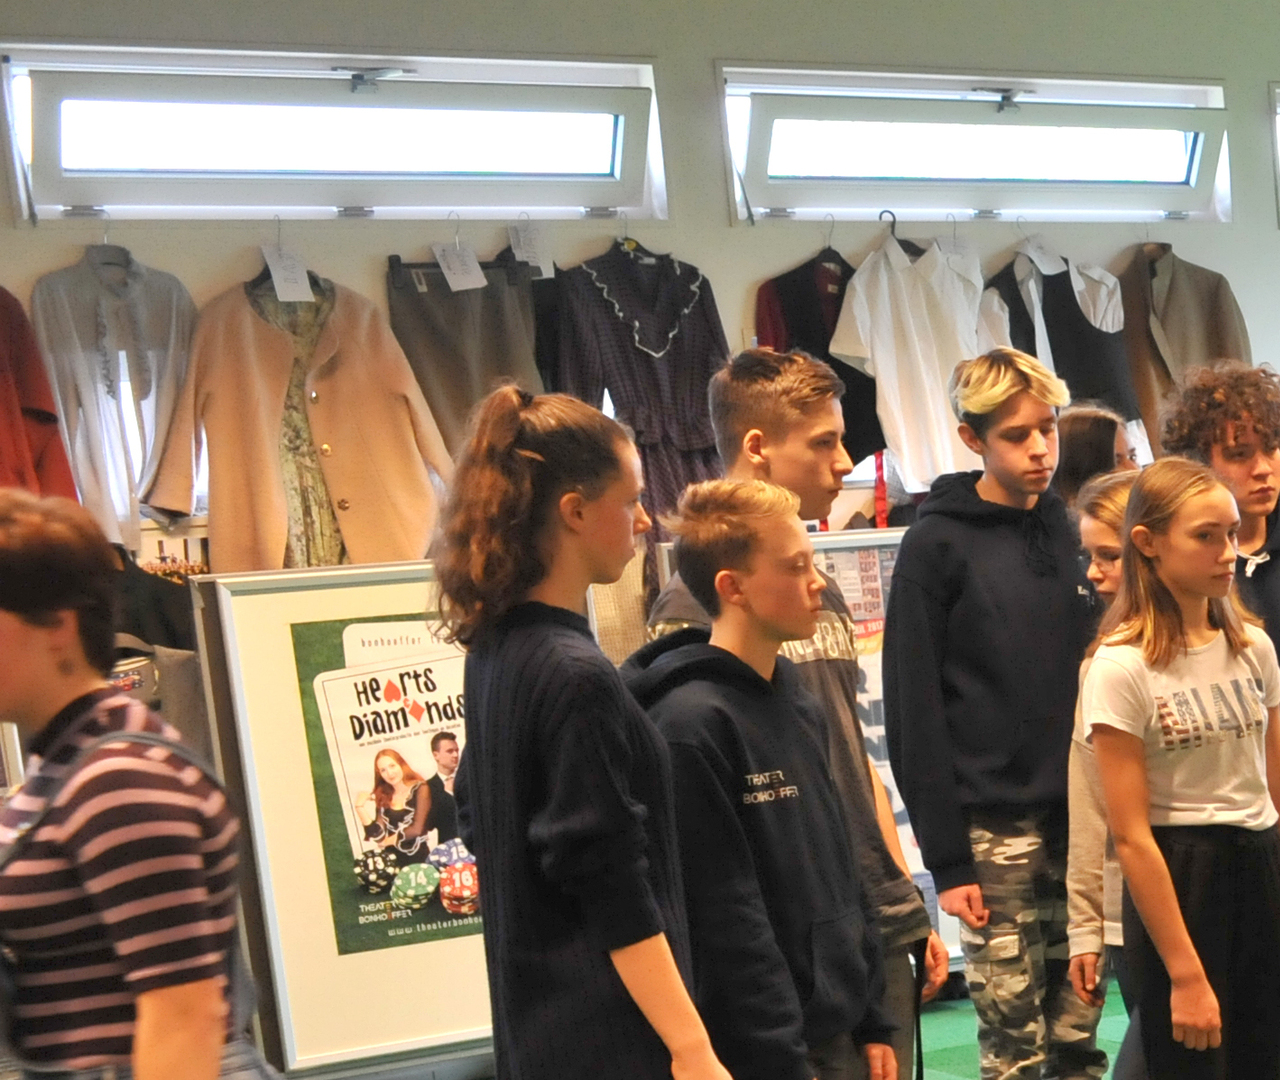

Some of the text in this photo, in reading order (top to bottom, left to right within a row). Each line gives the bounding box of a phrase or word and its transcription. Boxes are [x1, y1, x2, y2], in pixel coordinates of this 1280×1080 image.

[450, 844, 469, 861] 15
[366, 856, 385, 871] 13
[409, 870, 427, 888] 14
[452, 870, 474, 889] 16
